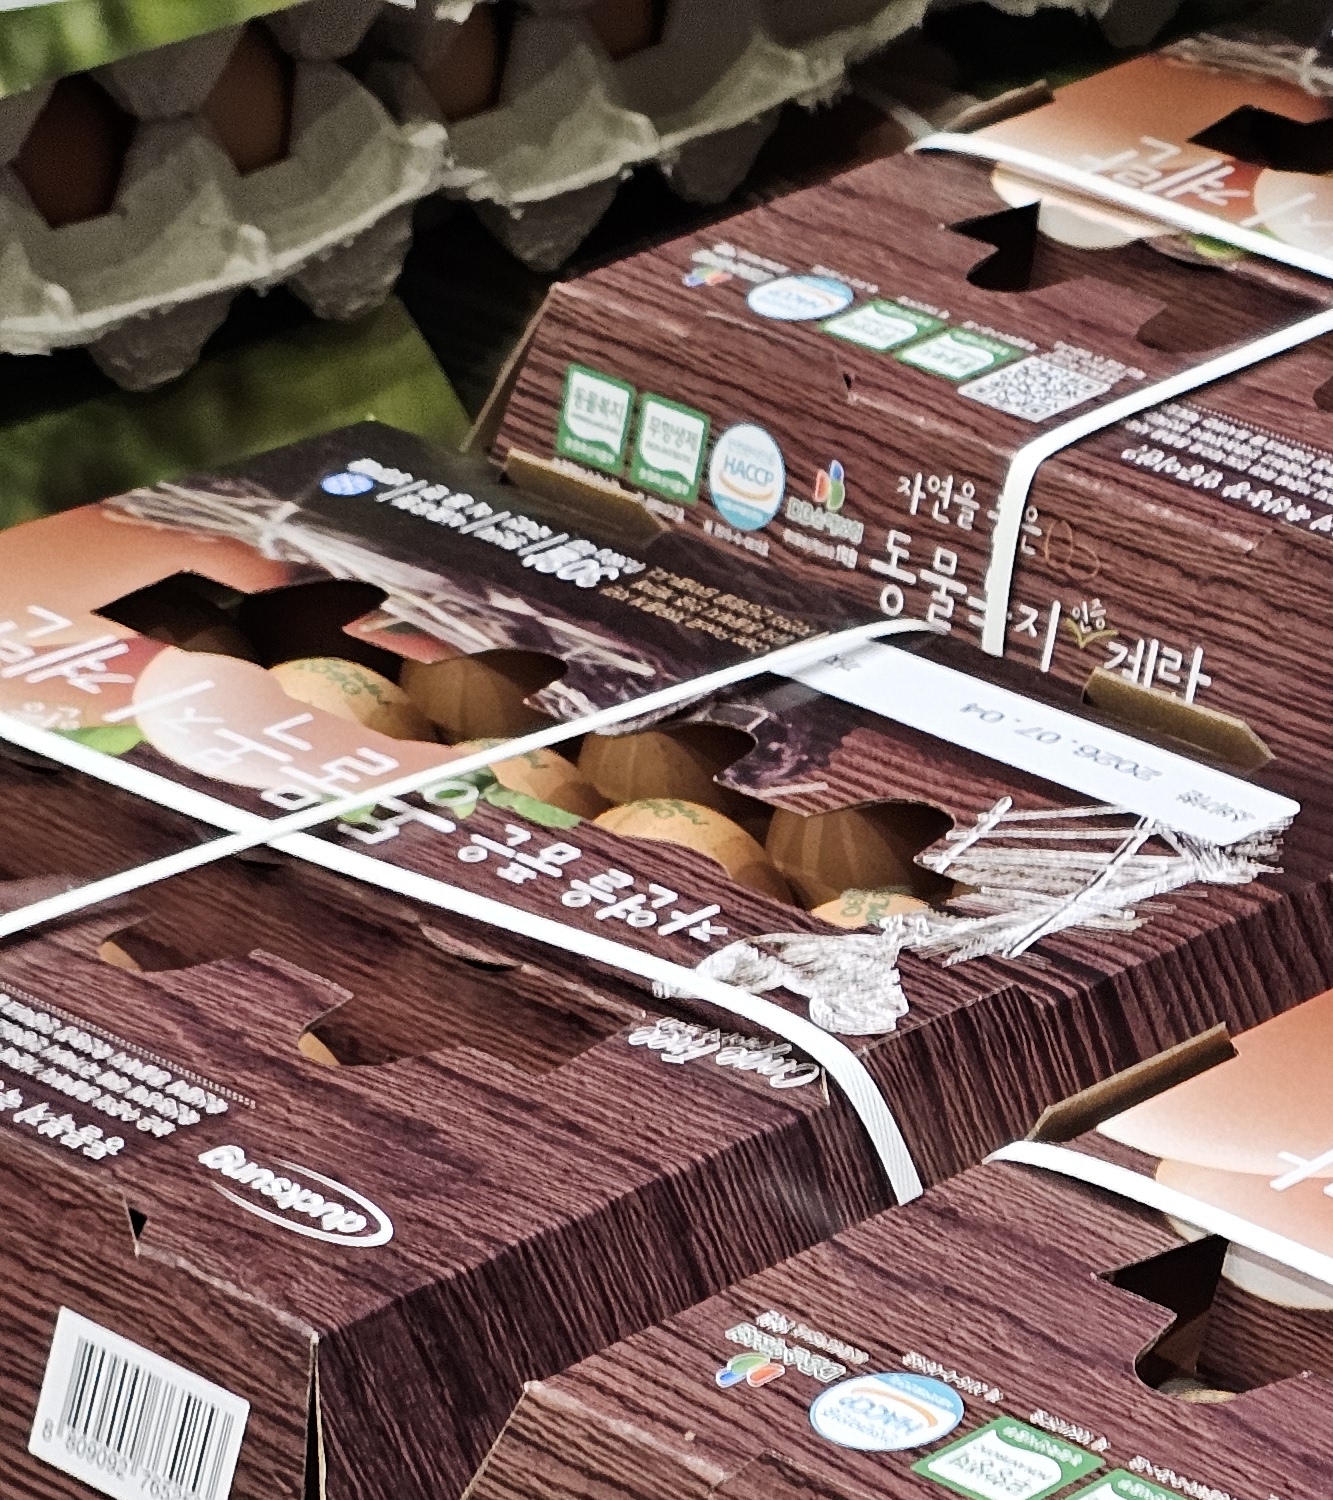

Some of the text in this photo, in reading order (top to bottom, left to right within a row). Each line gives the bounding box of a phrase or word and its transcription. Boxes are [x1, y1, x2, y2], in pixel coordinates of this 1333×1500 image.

[722, 453, 775, 490] HACCP
[897, 472, 977, 532] 자연을
[457, 824, 728, 941] 자연을 품은
